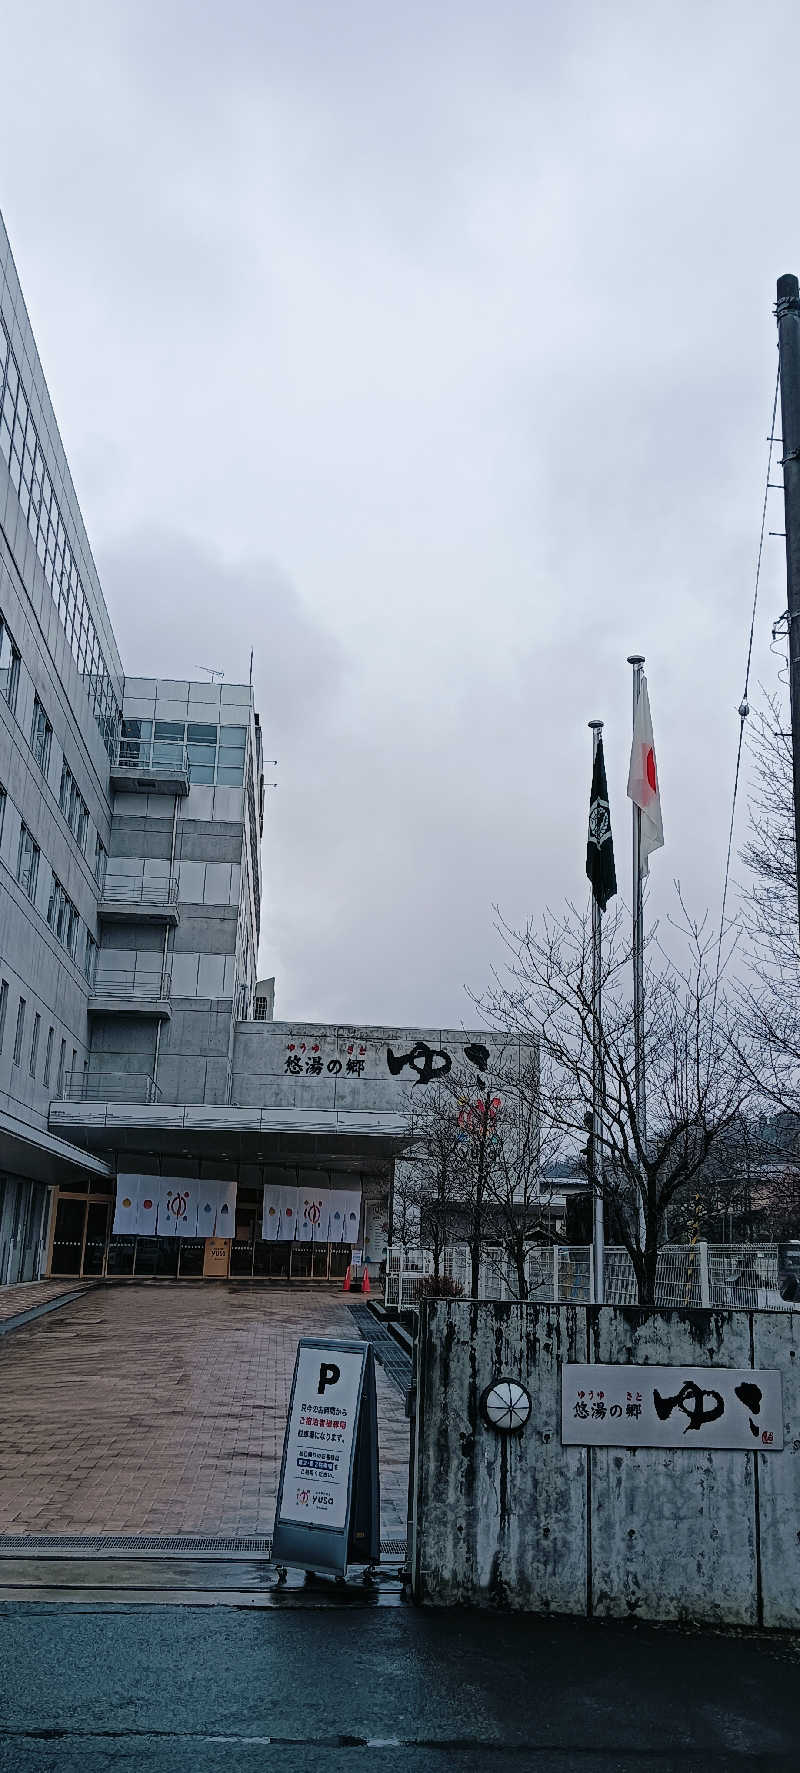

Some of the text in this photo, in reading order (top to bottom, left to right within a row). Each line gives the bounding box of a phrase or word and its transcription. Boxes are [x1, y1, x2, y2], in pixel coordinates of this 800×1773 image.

[287, 1042, 320, 1054] ゆうゆ
[284, 1055, 367, 1078] 悠湯の郷
[317, 1362, 341, 1395] P
[577, 1390, 643, 1402] ゆうゆ さと
[573, 1401, 642, 1421] 悠湯の郷
